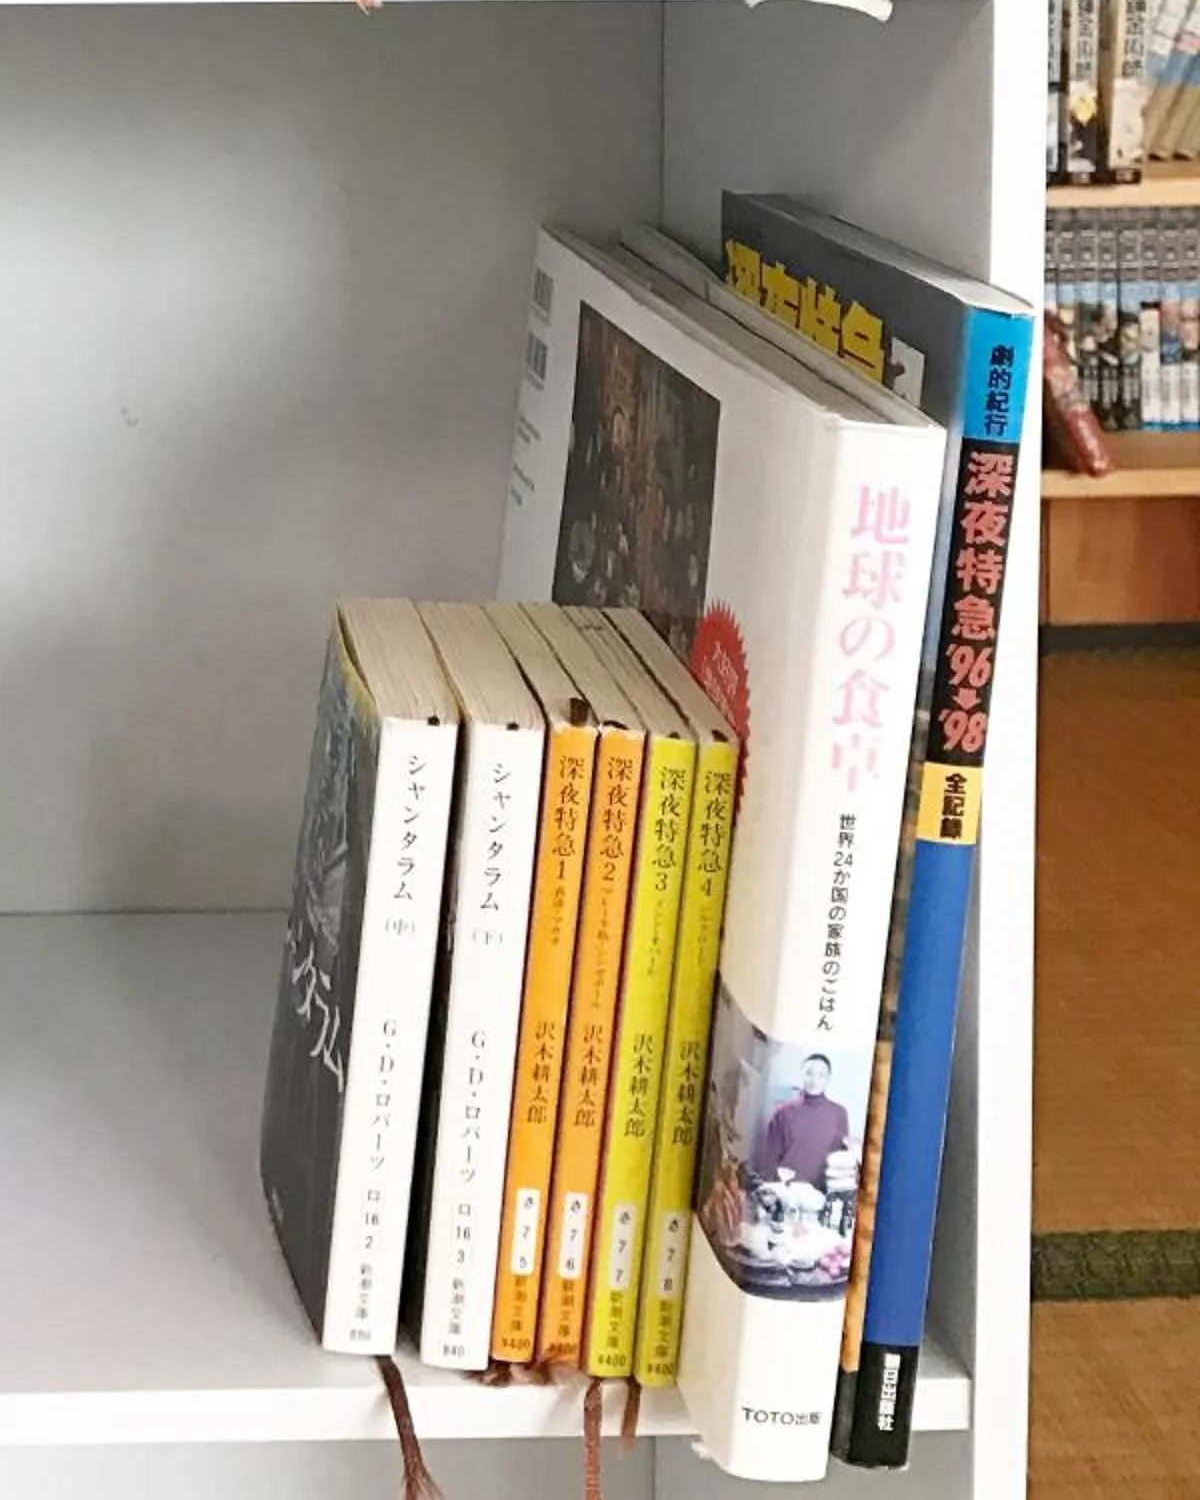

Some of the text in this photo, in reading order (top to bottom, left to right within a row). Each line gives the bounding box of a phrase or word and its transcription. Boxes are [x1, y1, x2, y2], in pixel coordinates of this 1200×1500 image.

[830, 484, 912, 794] 地球の食卓
[393, 755, 427, 902] シャンタラム
[480, 763, 512, 911] シャンタラム
[527, 1022, 555, 1124] 沢木耕太郎
[573, 1024, 603, 1127] 沢木耕太郎
[624, 1033, 654, 1138] 沢木耕太郎
[671, 1040, 701, 1146] 沢木耕太郎
[741, 1405, 821, 1427] TOTO出版
